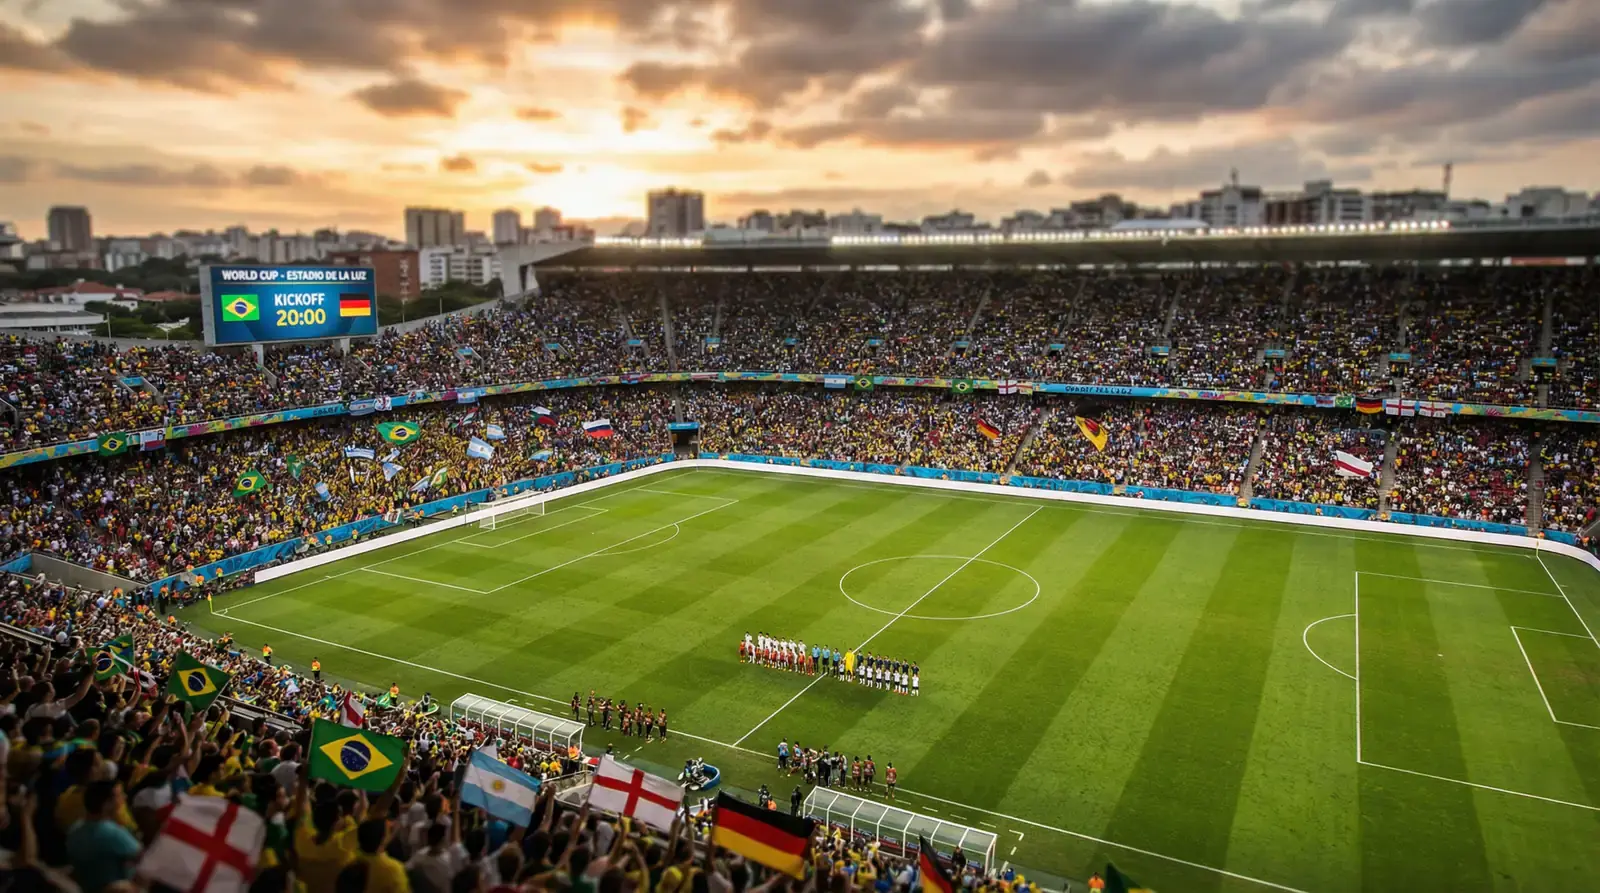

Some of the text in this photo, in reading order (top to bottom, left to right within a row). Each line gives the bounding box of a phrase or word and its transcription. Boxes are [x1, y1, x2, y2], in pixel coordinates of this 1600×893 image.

[222, 270, 257, 280] WORLD
[259, 270, 277, 280] CUP
[287, 271, 325, 280] ESTADIO
[325, 271, 338, 280] DE
[338, 271, 350, 280] LA
[351, 271, 367, 280] LUZ
[274, 293, 325, 306] KICKOFF
[276, 308, 326, 326] 20:00
